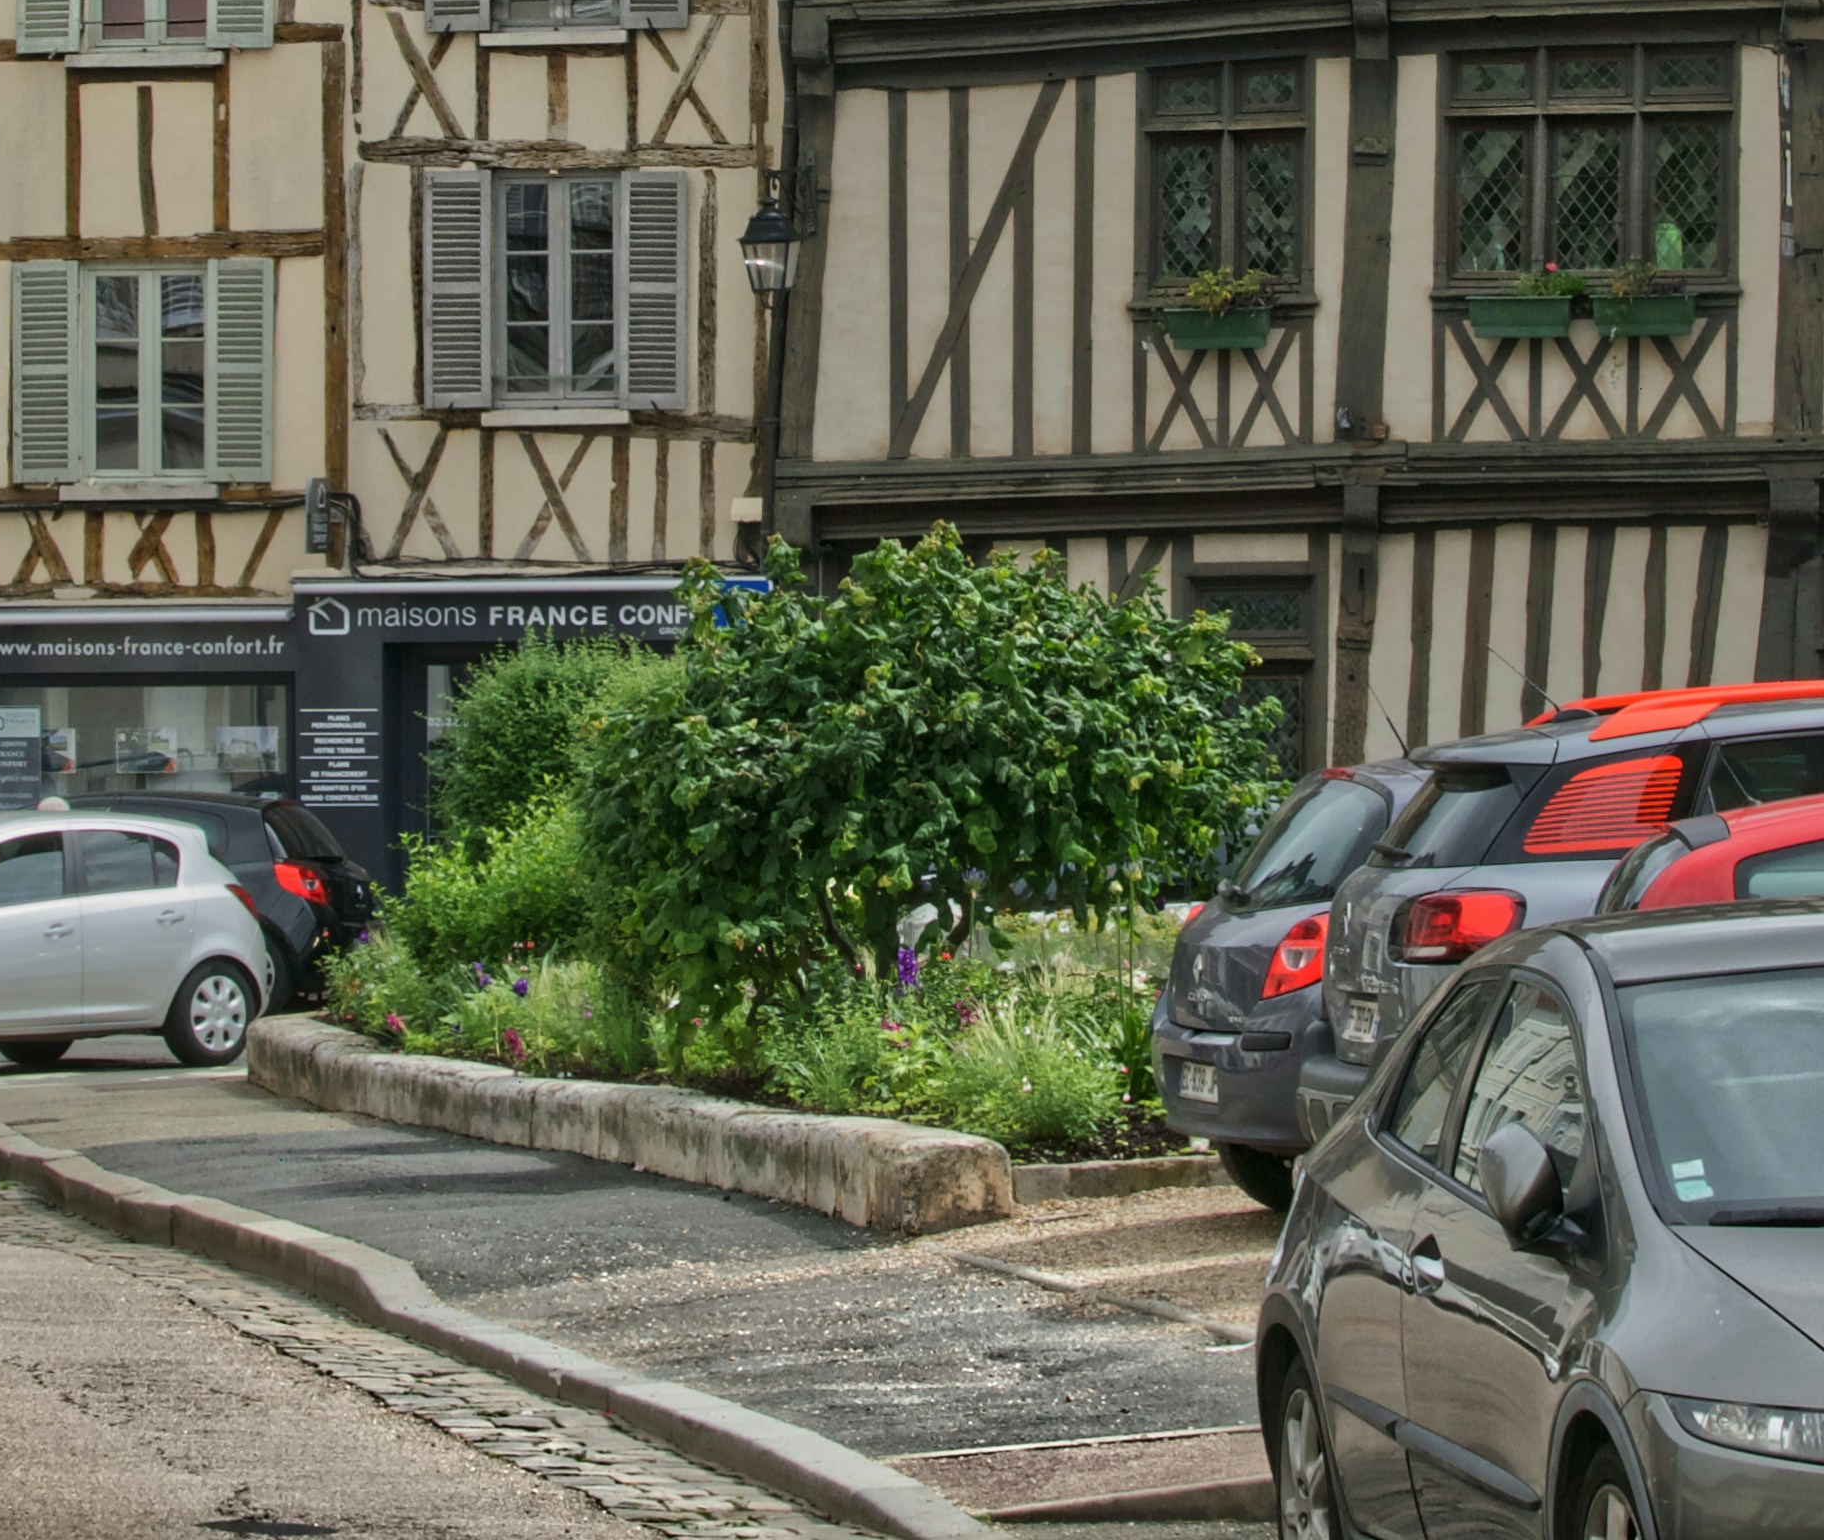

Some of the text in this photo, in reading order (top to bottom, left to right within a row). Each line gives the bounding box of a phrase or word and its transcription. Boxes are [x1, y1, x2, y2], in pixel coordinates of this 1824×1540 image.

[357, 602, 695, 627] maisons FRANCE CONF
